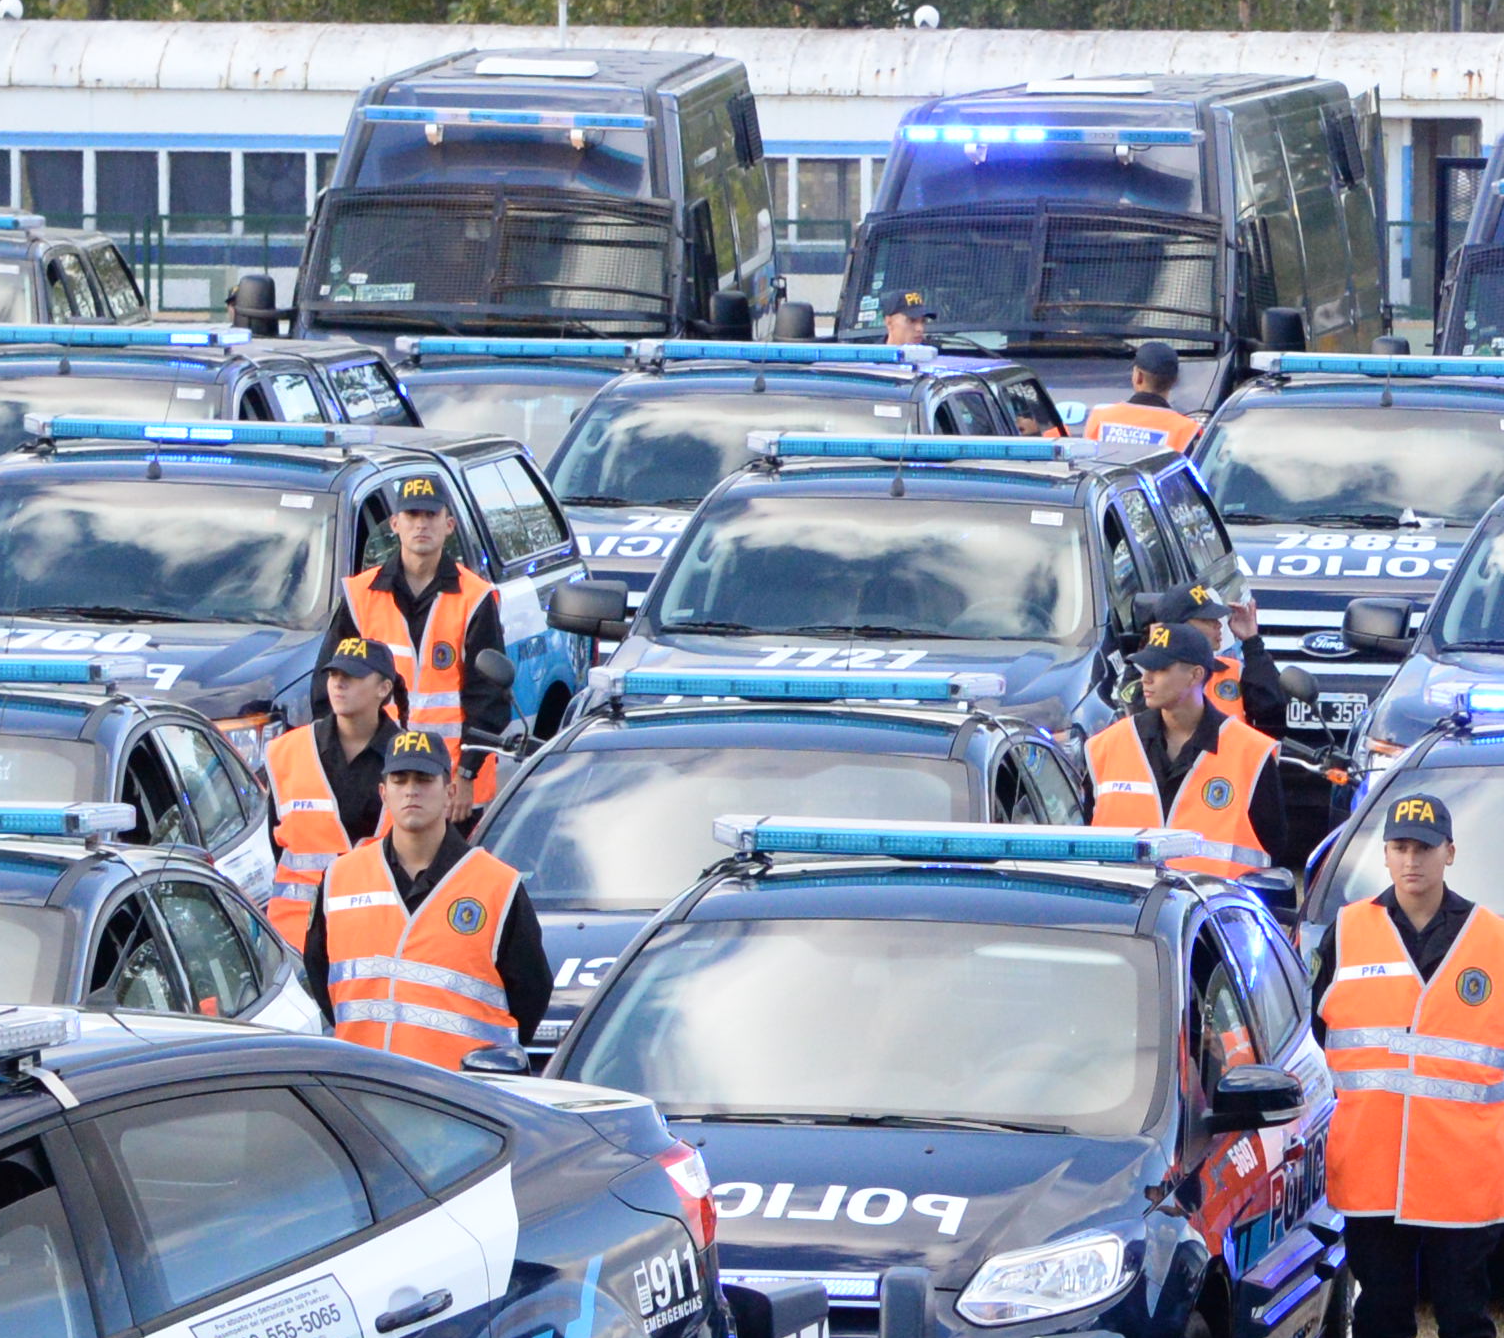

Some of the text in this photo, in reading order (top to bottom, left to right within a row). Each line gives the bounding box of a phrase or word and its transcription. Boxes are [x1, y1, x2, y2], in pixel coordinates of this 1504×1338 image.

[1108, 426, 1151, 441] POLICIA
[403, 479, 434, 498] PFA
[1274, 534, 1437, 552] 7885
[1149, 627, 1169, 647] FA
[335, 638, 367, 659] PFA
[753, 647, 929, 670] 7727
[393, 732, 431, 757] PFA
[1113, 782, 1132, 791] PFA
[293, 800, 314, 811] PFA
[1395, 800, 1435, 824] PFA
[351, 895, 373, 907] PFA
[1363, 965, 1386, 977] PFA
[1227, 1136, 1259, 1178] 5697
[649, 1241, 700, 1308] 911
[643, 1295, 703, 1335] EMERGENCIAS
